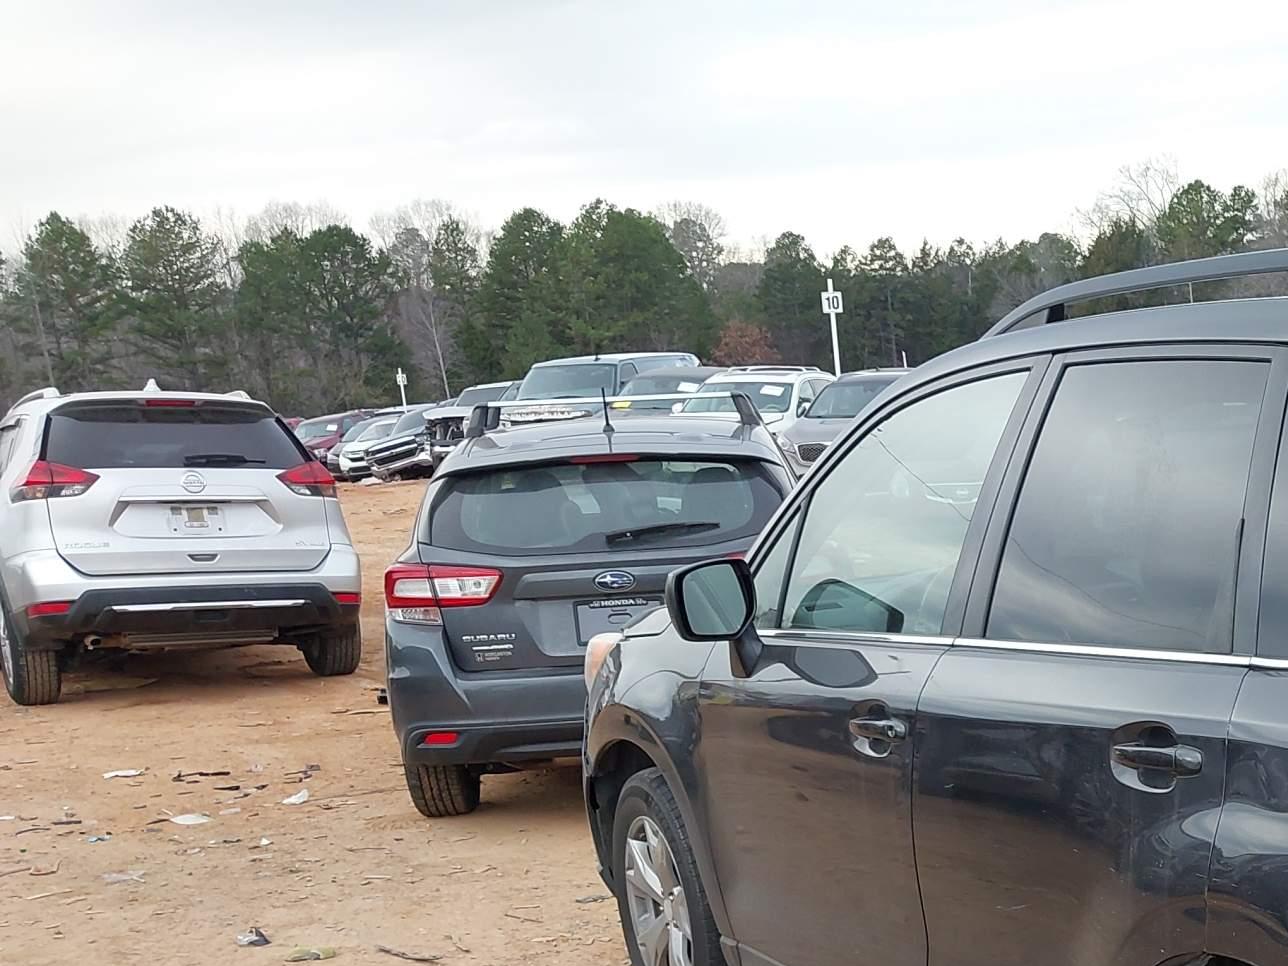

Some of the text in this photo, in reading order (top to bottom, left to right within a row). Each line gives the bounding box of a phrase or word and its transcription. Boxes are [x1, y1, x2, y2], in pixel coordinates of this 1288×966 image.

[825, 295, 840, 310] 10
[600, 598, 636, 608] HONDA
[462, 633, 516, 643] SUBARU
